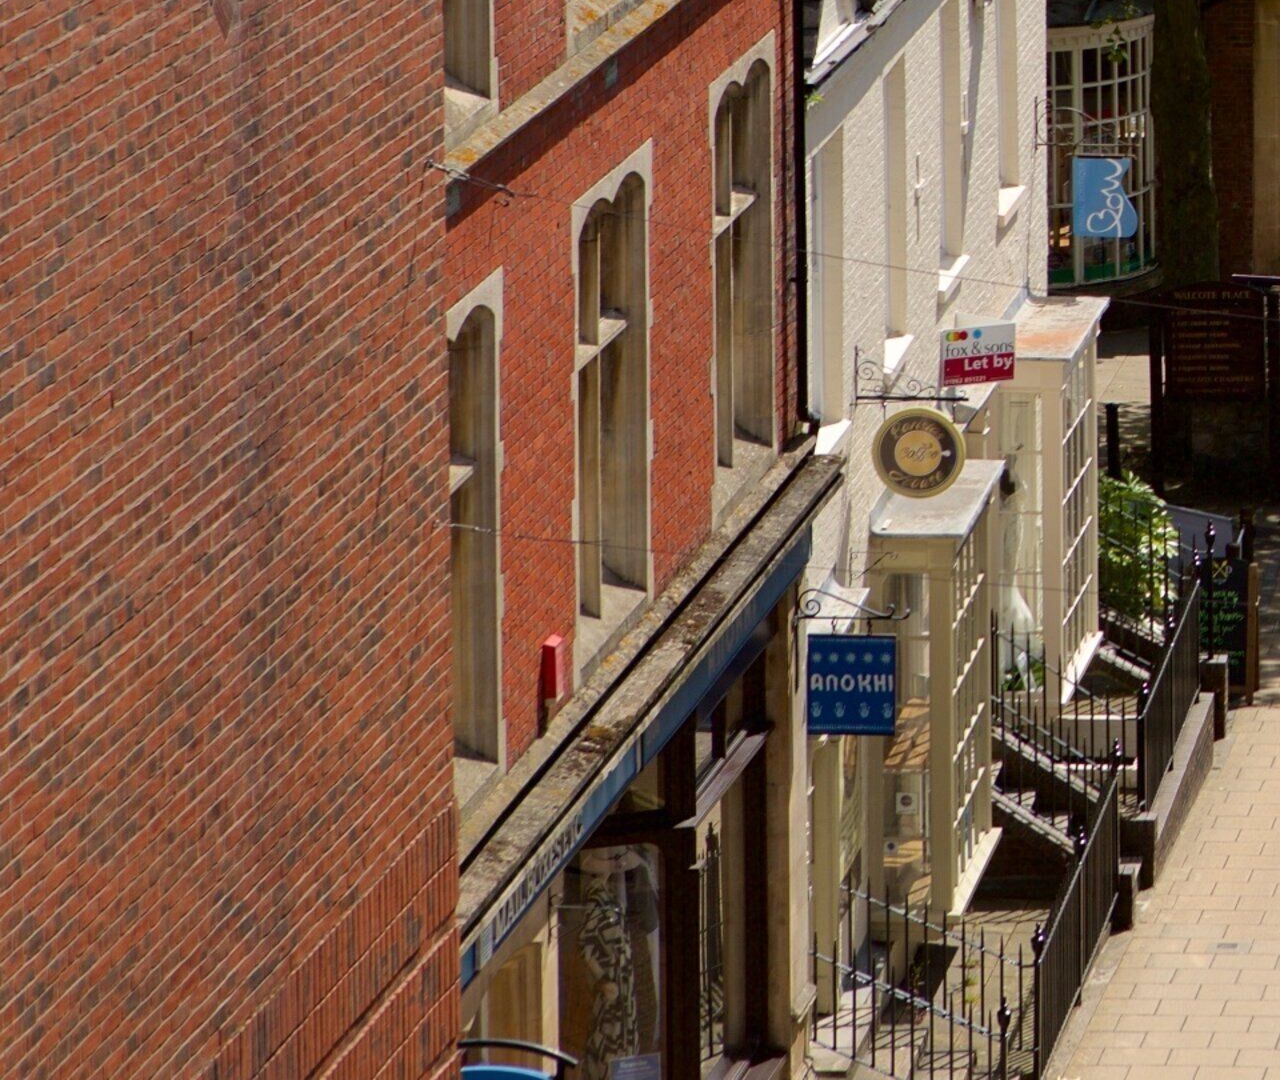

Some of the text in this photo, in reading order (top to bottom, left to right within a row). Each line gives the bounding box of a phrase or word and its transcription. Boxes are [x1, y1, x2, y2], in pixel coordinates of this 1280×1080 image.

[945, 341, 1015, 358] fox & sons
[964, 354, 1013, 371] Let by
